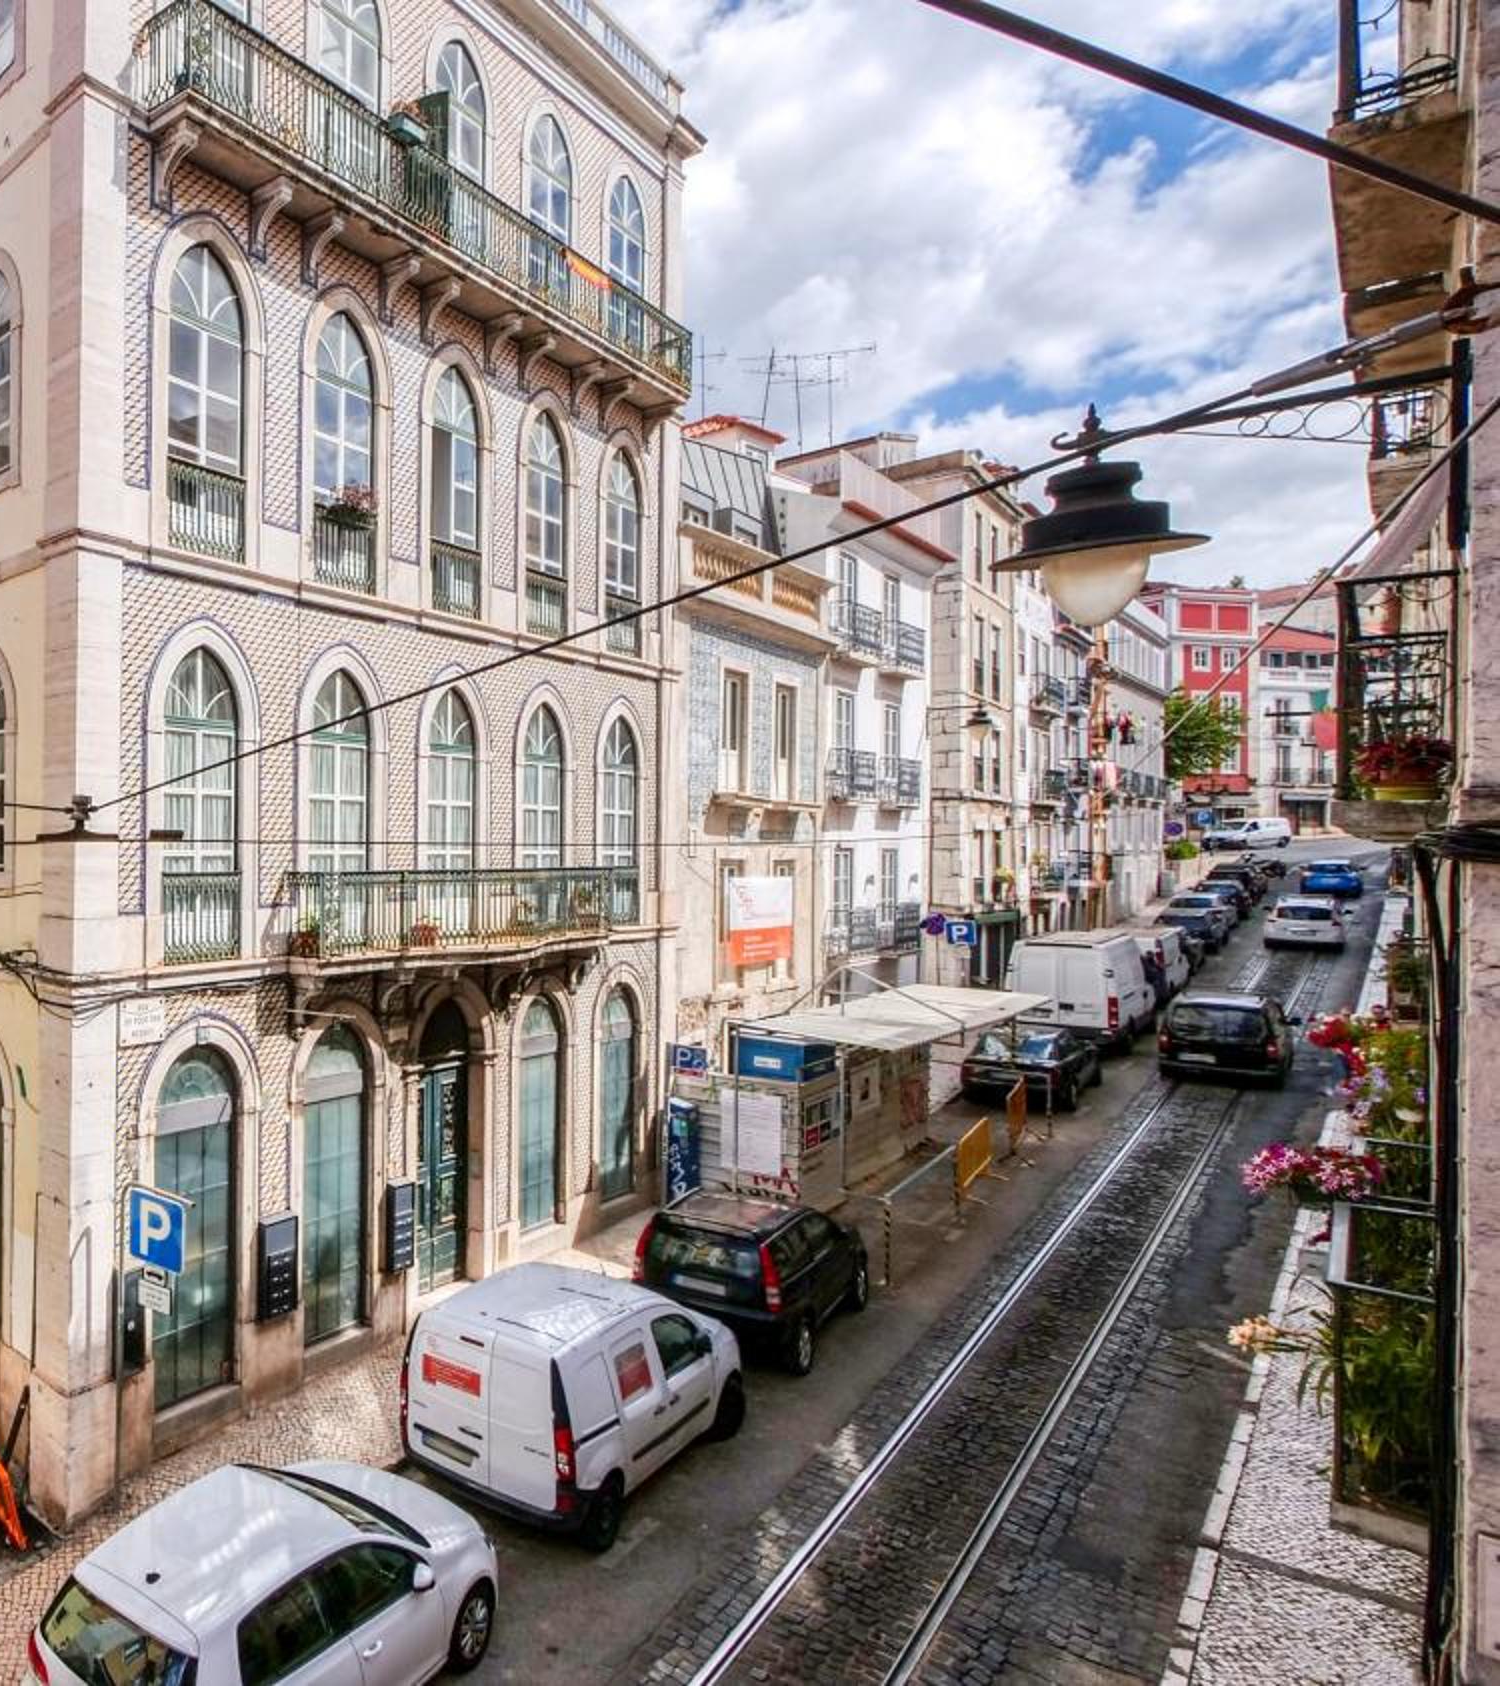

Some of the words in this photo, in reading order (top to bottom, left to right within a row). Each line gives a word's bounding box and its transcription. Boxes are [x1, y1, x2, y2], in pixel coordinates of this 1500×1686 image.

[951, 925, 968, 942] P
[676, 1048, 691, 1067] P
[140, 1199, 171, 1256] P
